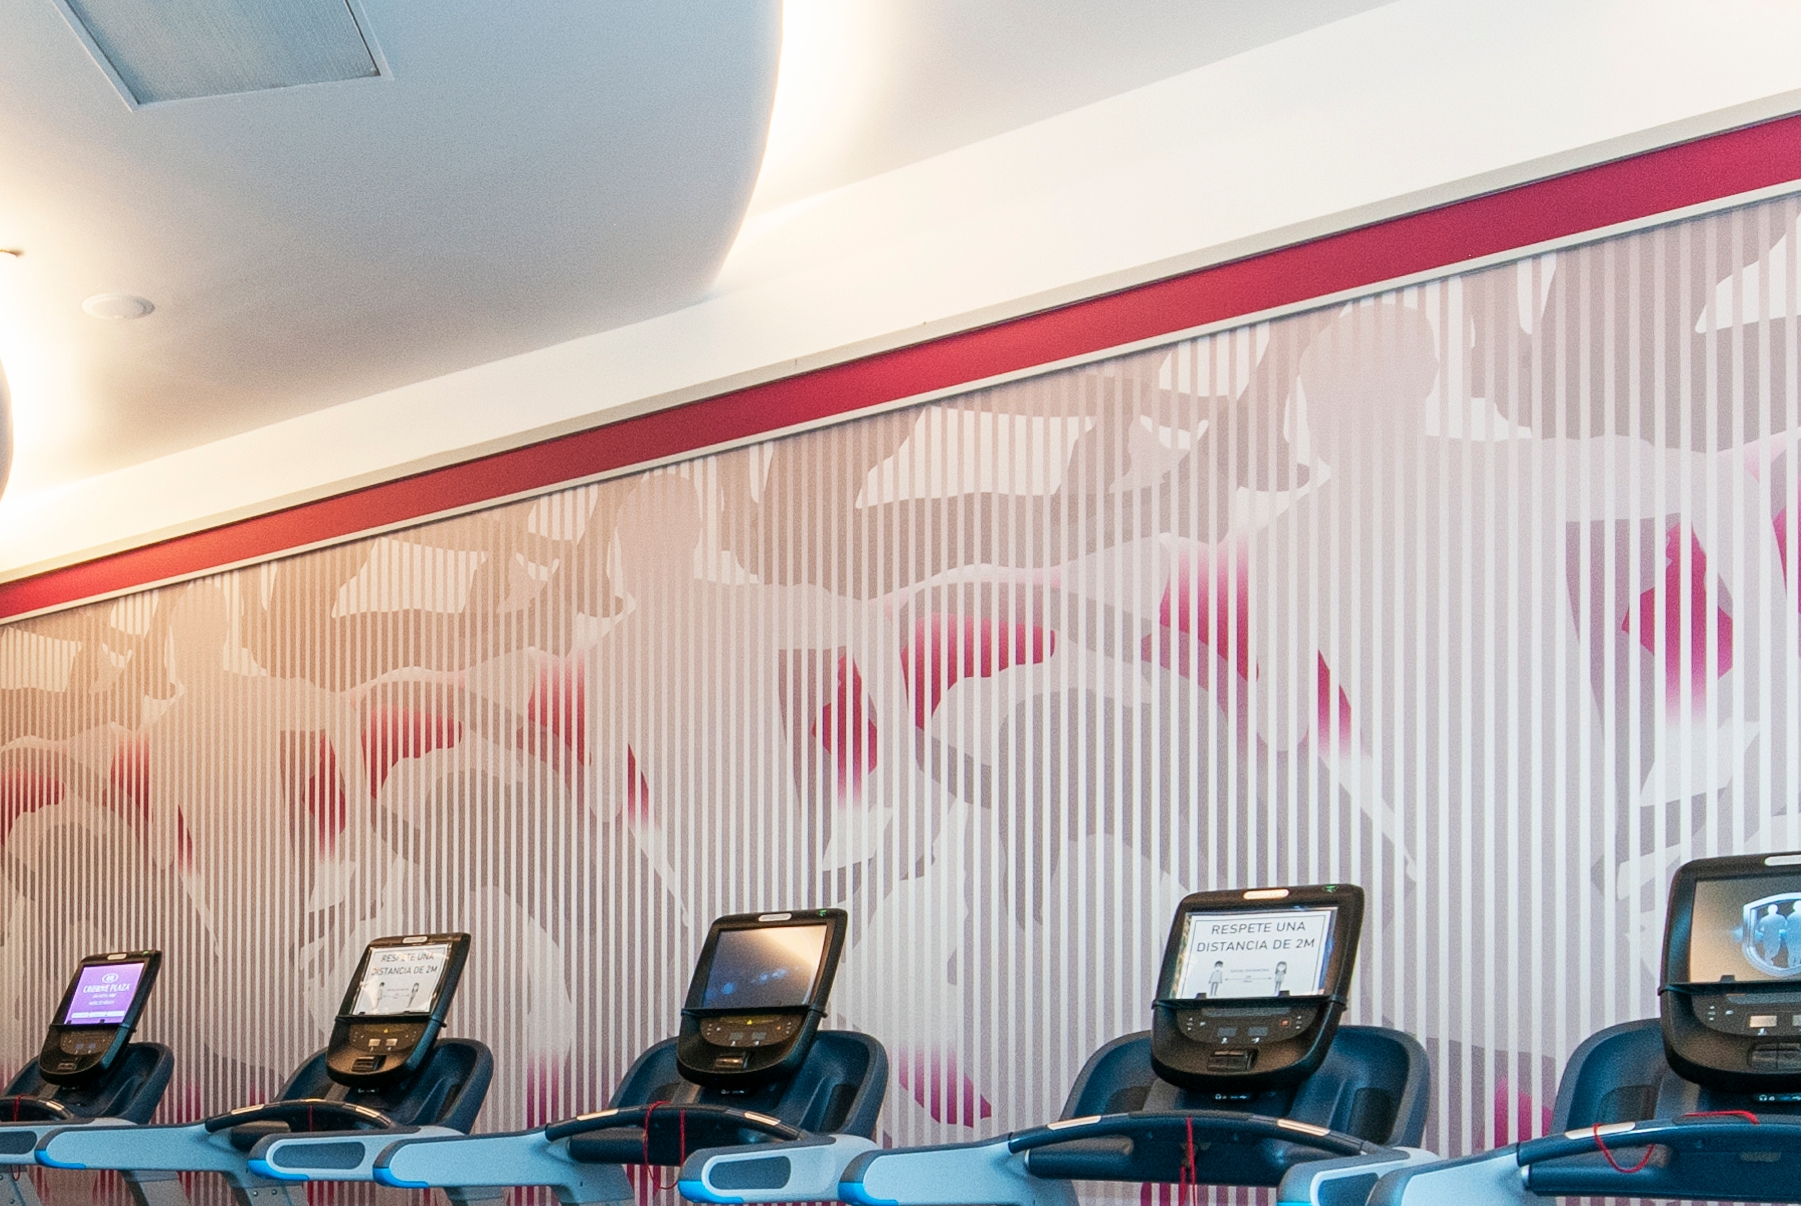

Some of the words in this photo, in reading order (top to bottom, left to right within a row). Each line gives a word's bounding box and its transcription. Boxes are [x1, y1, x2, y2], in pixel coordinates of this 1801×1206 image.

[1211, 922, 1273, 935] RESPETE
[1276, 921, 1306, 932] UNA
[1196, 940, 1268, 952] DISTANCIA
[1272, 939, 1290, 950] DE
[1295, 938, 1315, 949] 2M
[371, 966, 412, 976] DISTANCIA
[413, 965, 425, 974] DE
[426, 965, 438, 973] 2M
